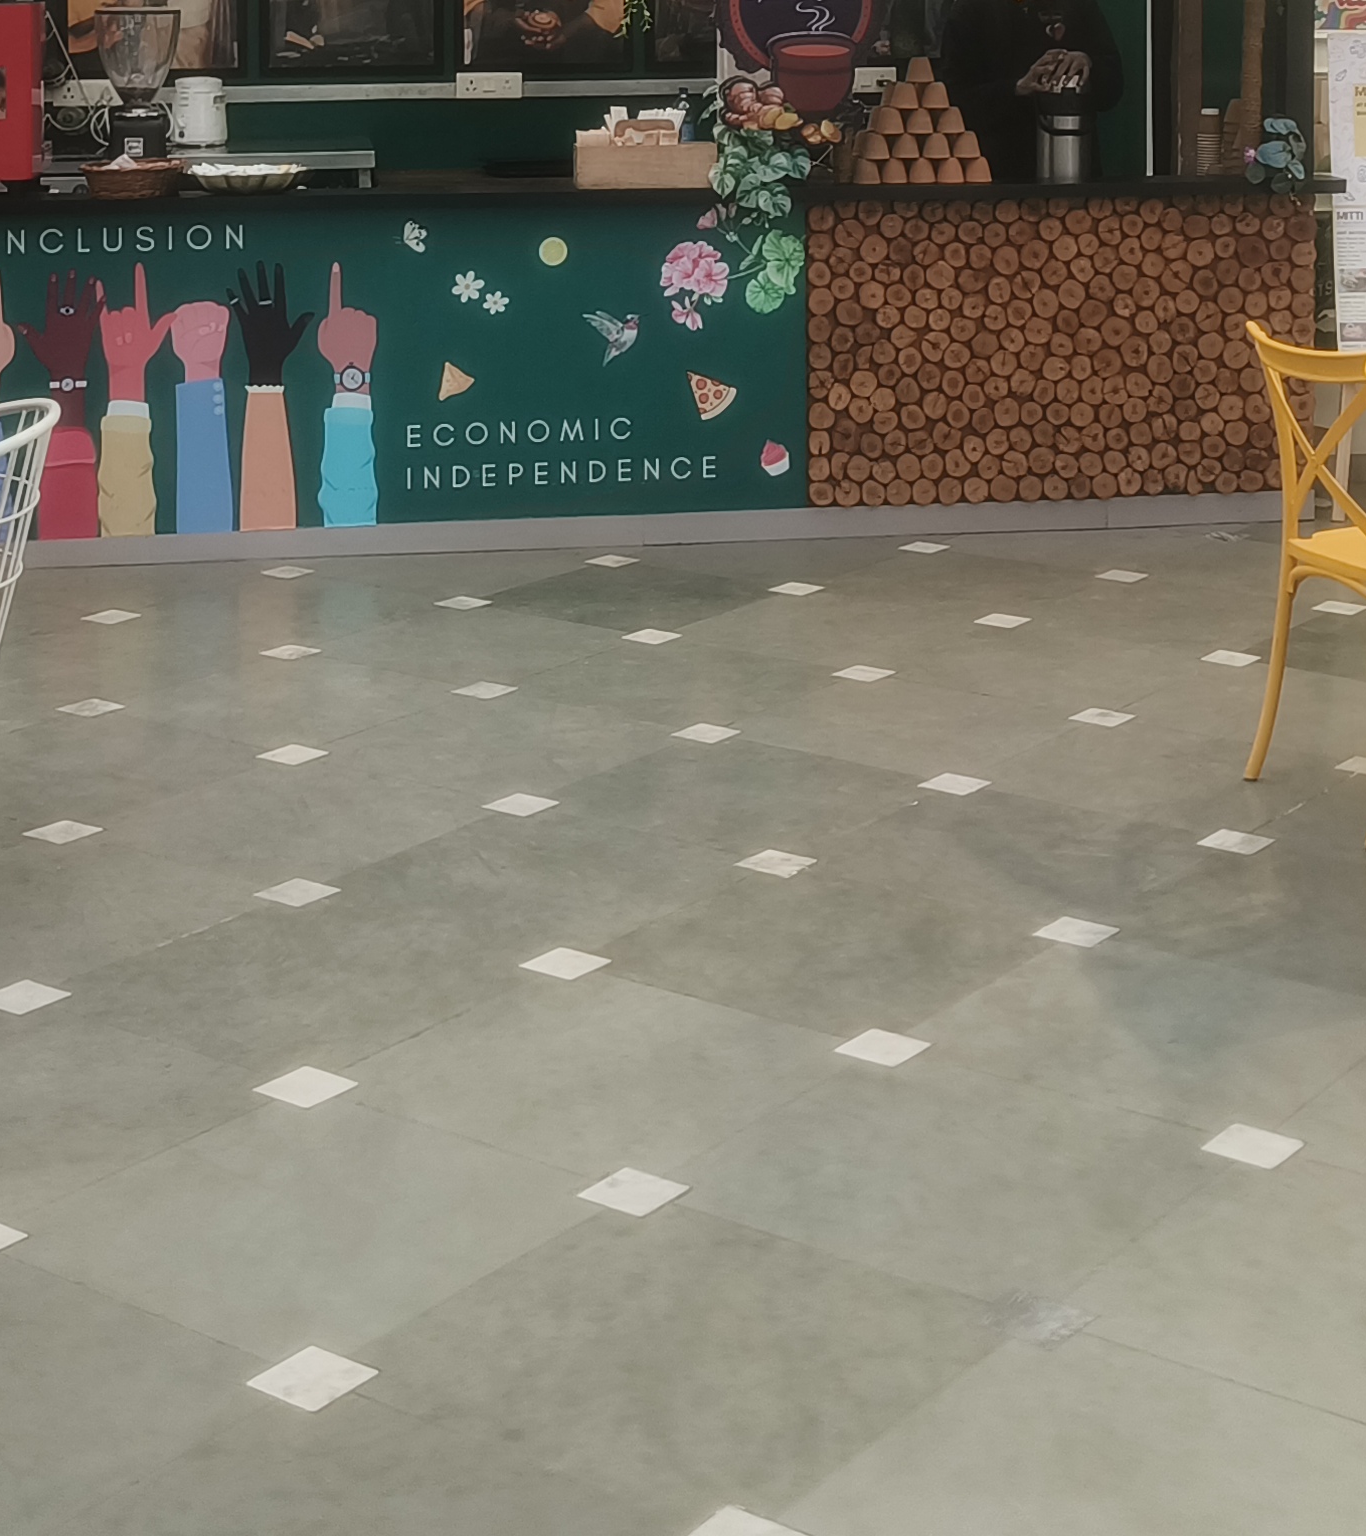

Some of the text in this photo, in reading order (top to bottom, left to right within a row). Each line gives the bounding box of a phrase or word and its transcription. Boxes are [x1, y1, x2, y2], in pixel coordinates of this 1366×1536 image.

[1336, 211, 1364, 221] MITTI
[406, 417, 632, 448] ECONOMIC
[406, 455, 717, 490] INDEPENDENCE
